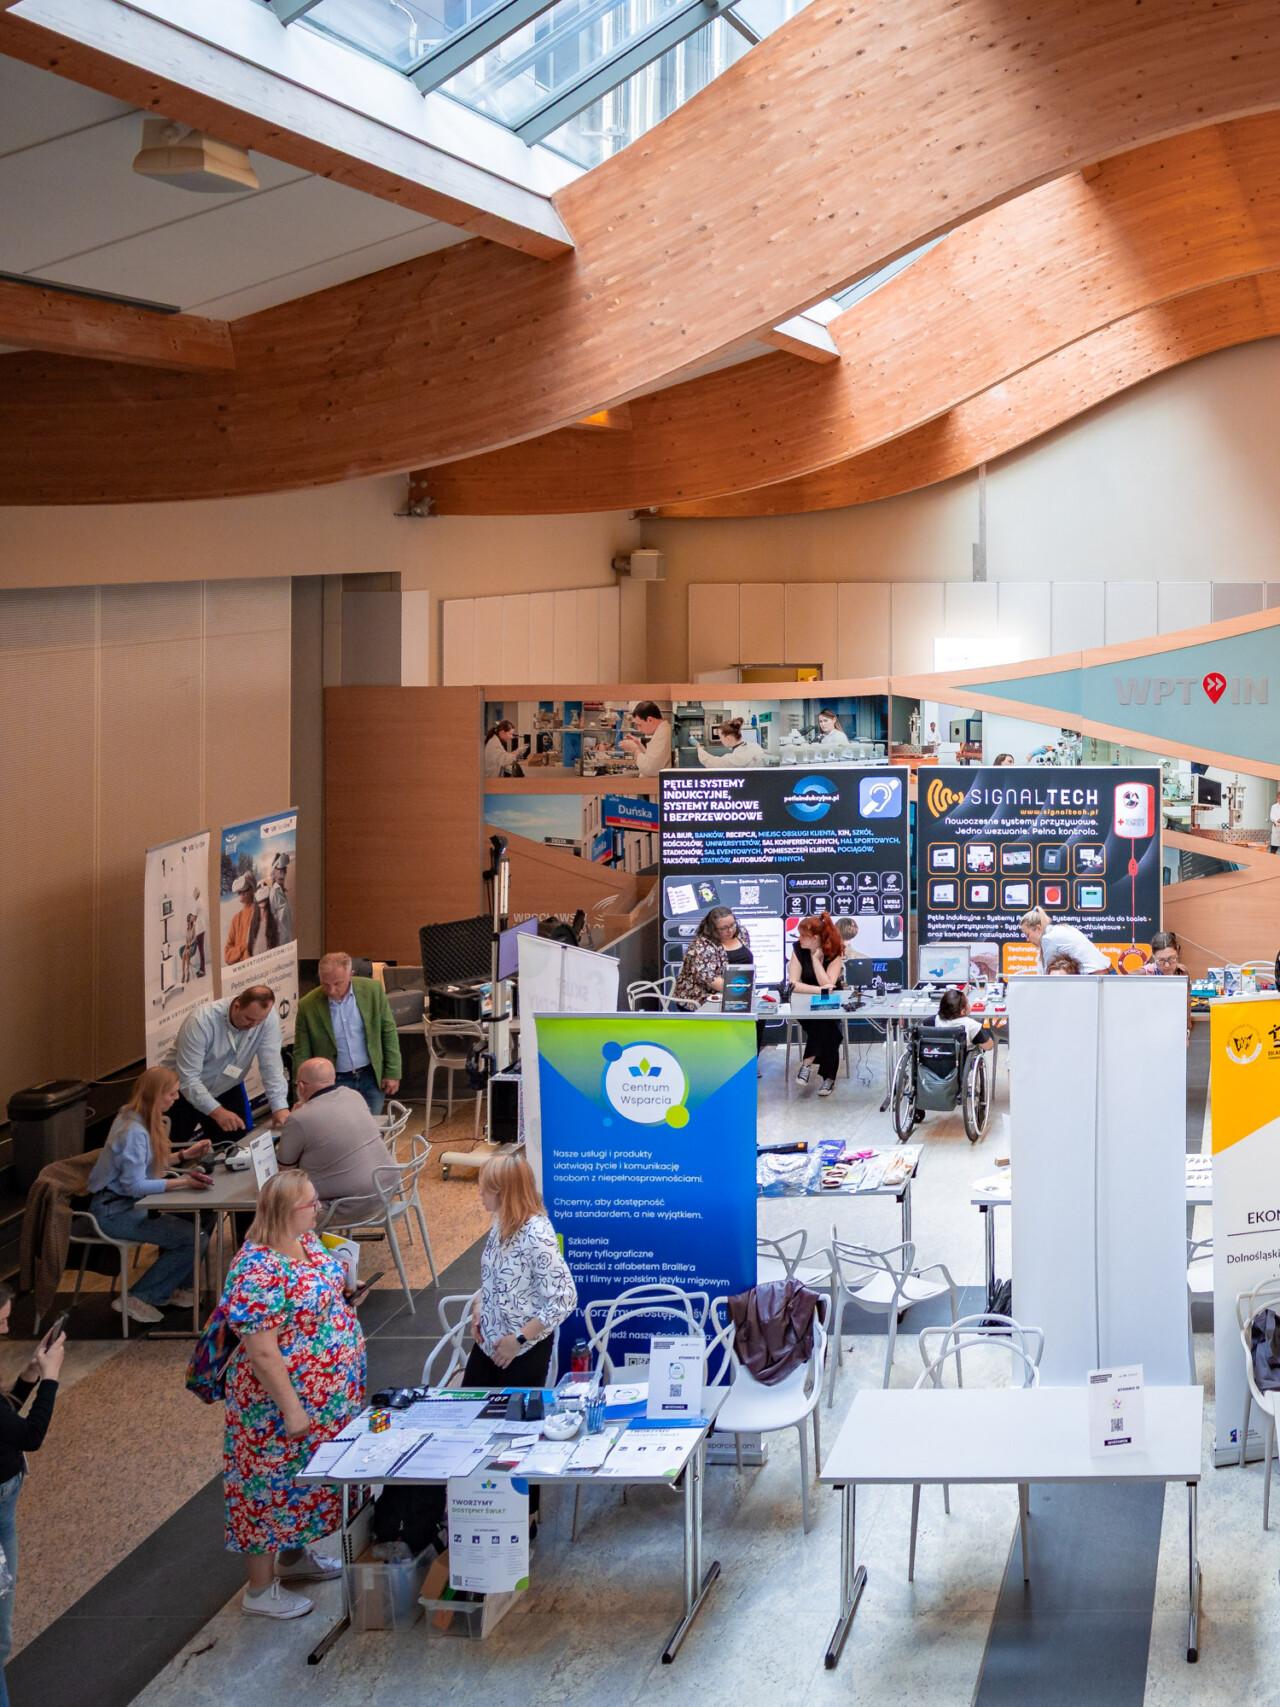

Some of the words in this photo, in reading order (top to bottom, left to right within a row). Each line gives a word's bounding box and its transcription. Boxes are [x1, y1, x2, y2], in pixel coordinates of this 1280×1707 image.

[1114, 677, 1197, 705] WPT
[1231, 677, 1268, 704] IN
[663, 779, 693, 790] PĘTLE
[700, 779, 745, 788] SYSTEMY
[664, 790, 731, 800] INDUKCYJNE,
[971, 789, 1098, 805] SIGNALTECH
[664, 802, 708, 810] SYSTEMY
[710, 801, 759, 810] RADIOWE
[618, 805, 652, 818] Duńska
[670, 812, 763, 821] BEZPRZEWODOWE
[1001, 818, 1038, 826] systemy
[1040, 818, 1098, 826] przyzywowe.
[695, 831, 725, 839] BANKÓW,
[706, 839, 761, 847] UNIWERSYTETÓW,
[622, 1082, 669, 1093] Centrum
[620, 1095, 672, 1107] Wsparcia
[553, 1150, 578, 1158] Nasze
[581, 1150, 607, 1160] usługi
[614, 1150, 652, 1159] produkty
[554, 1162, 593, 1171] ułatwiają
[595, 1162, 617, 1171] życie
[624, 1162, 680, 1172] komunikację
[598, 1174, 703, 1183] niepełnosprawnościami.
[554, 1198, 592, 1207] Chcemy,
[595, 1198, 611, 1207] aby
[614, 1198, 665, 1207] dostępność
[554, 1210, 572, 1219] była
[575, 1210, 632, 1219] standardem,
[642, 1210, 655, 1218] nie
[657, 1210, 703, 1220] wyjątkiem.
[568, 1237, 609, 1245] Szkolenia
[568, 1250, 592, 1259] Plany
[594, 1250, 654, 1259] tyflograficzne
[1227, 1248, 1280, 1264] Dolnośląski
[568, 1263, 606, 1271] Tabliczki
[614, 1263, 660, 1271] alfabetem
[590, 1276, 612, 1285] filmy
[623, 1276, 657, 1285] polskim
[659, 1276, 686, 1286] języku
[688, 1277, 730, 1286] migowym
